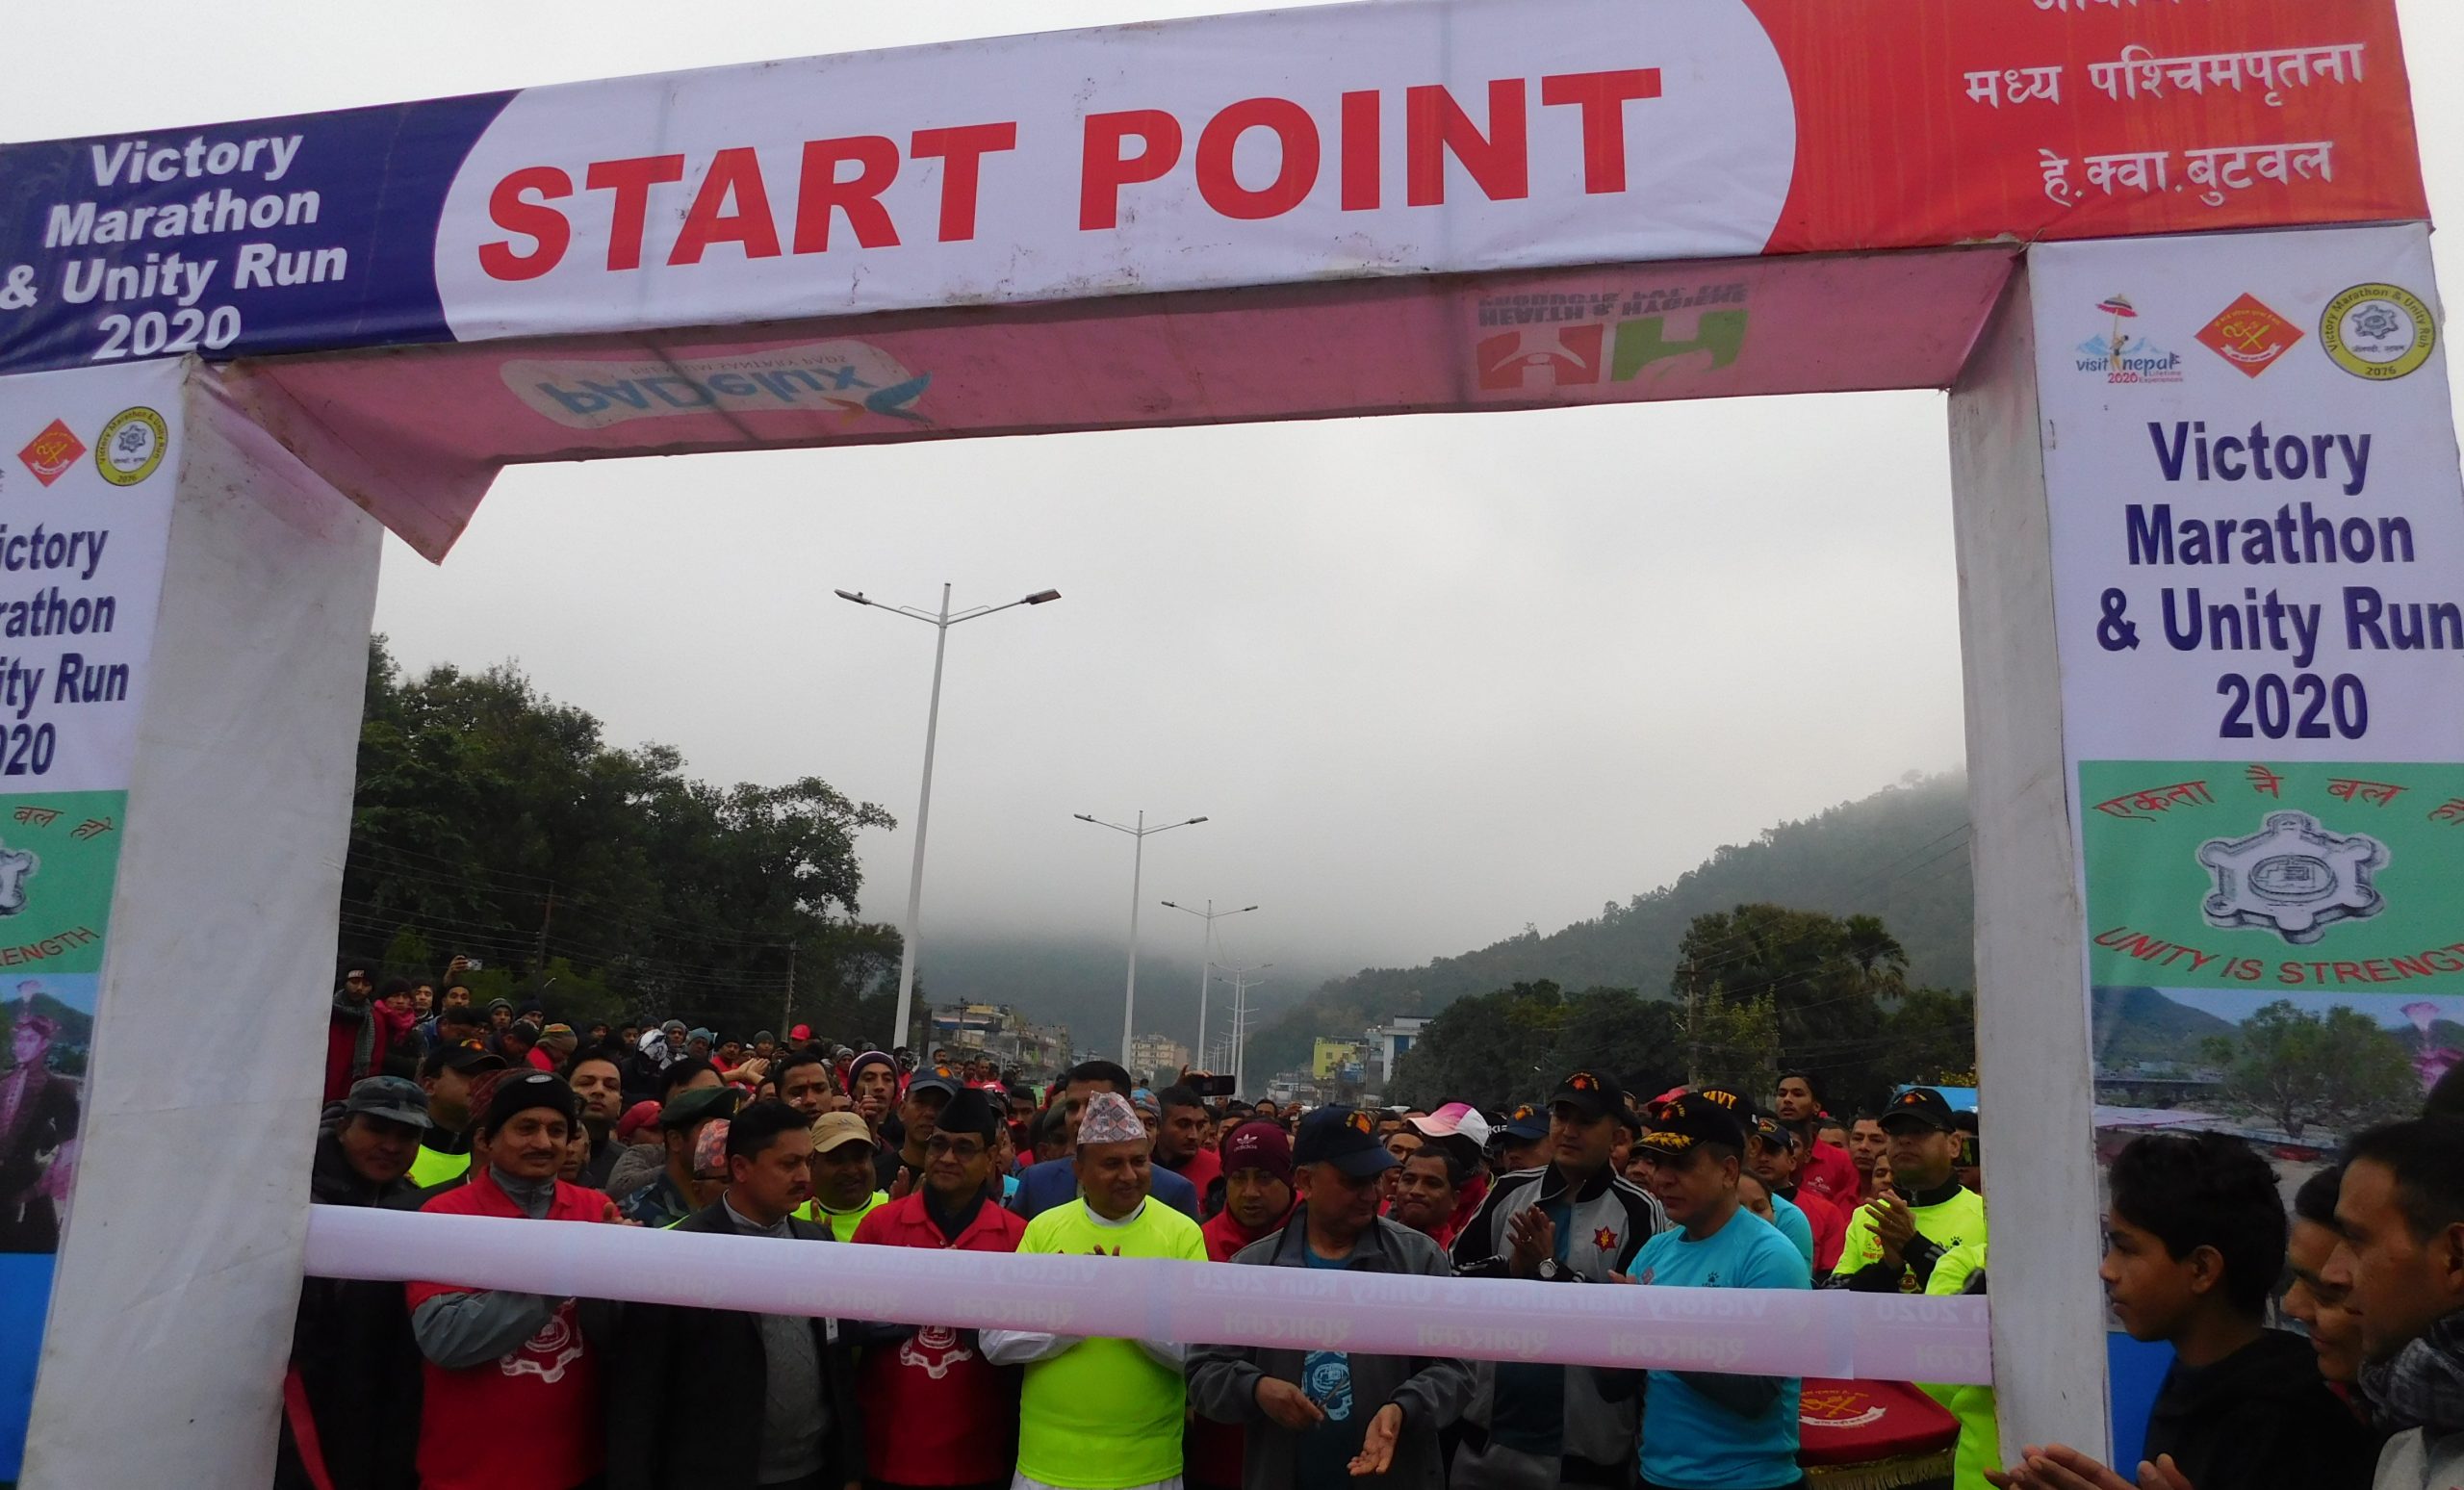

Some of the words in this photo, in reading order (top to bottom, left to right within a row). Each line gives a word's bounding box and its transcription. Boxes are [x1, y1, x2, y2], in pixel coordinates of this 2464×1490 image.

[1964, 66, 2062, 108] मध्य
[91, 135, 303, 187] Victory
[478, 121, 1016, 281] START
[1079, 67, 1661, 230] POINT
[44, 190, 320, 248] Marathon
[0, 265, 38, 310] &
[61, 258, 217, 306] Unity
[234, 243, 347, 289] Run
[92, 305, 241, 361] 2020
[2076, 357, 2109, 372] visit
[2122, 352, 2174, 376] nepal
[2108, 372, 2138, 384] 2020
[2147, 421, 2372, 496] Victory
[0, 523, 109, 580] ictory
[2125, 501, 2415, 565] Marathon
[0, 587, 116, 638] athon
[2096, 587, 2141, 651] &
[2161, 586, 2322, 668] Unity
[2343, 585, 2464, 650] Run
[0, 656, 44, 720] ity
[54, 653, 129, 704] Run
[2217, 673, 2368, 740] 2020
[0, 722, 56, 776] 20
[2092, 781, 2216, 822] एकता
[2326, 778, 2410, 808] बल
[0, 926, 100, 965] ENGTH
[2093, 927, 2221, 973] UNITY
[2220, 958, 2263, 981] IS
